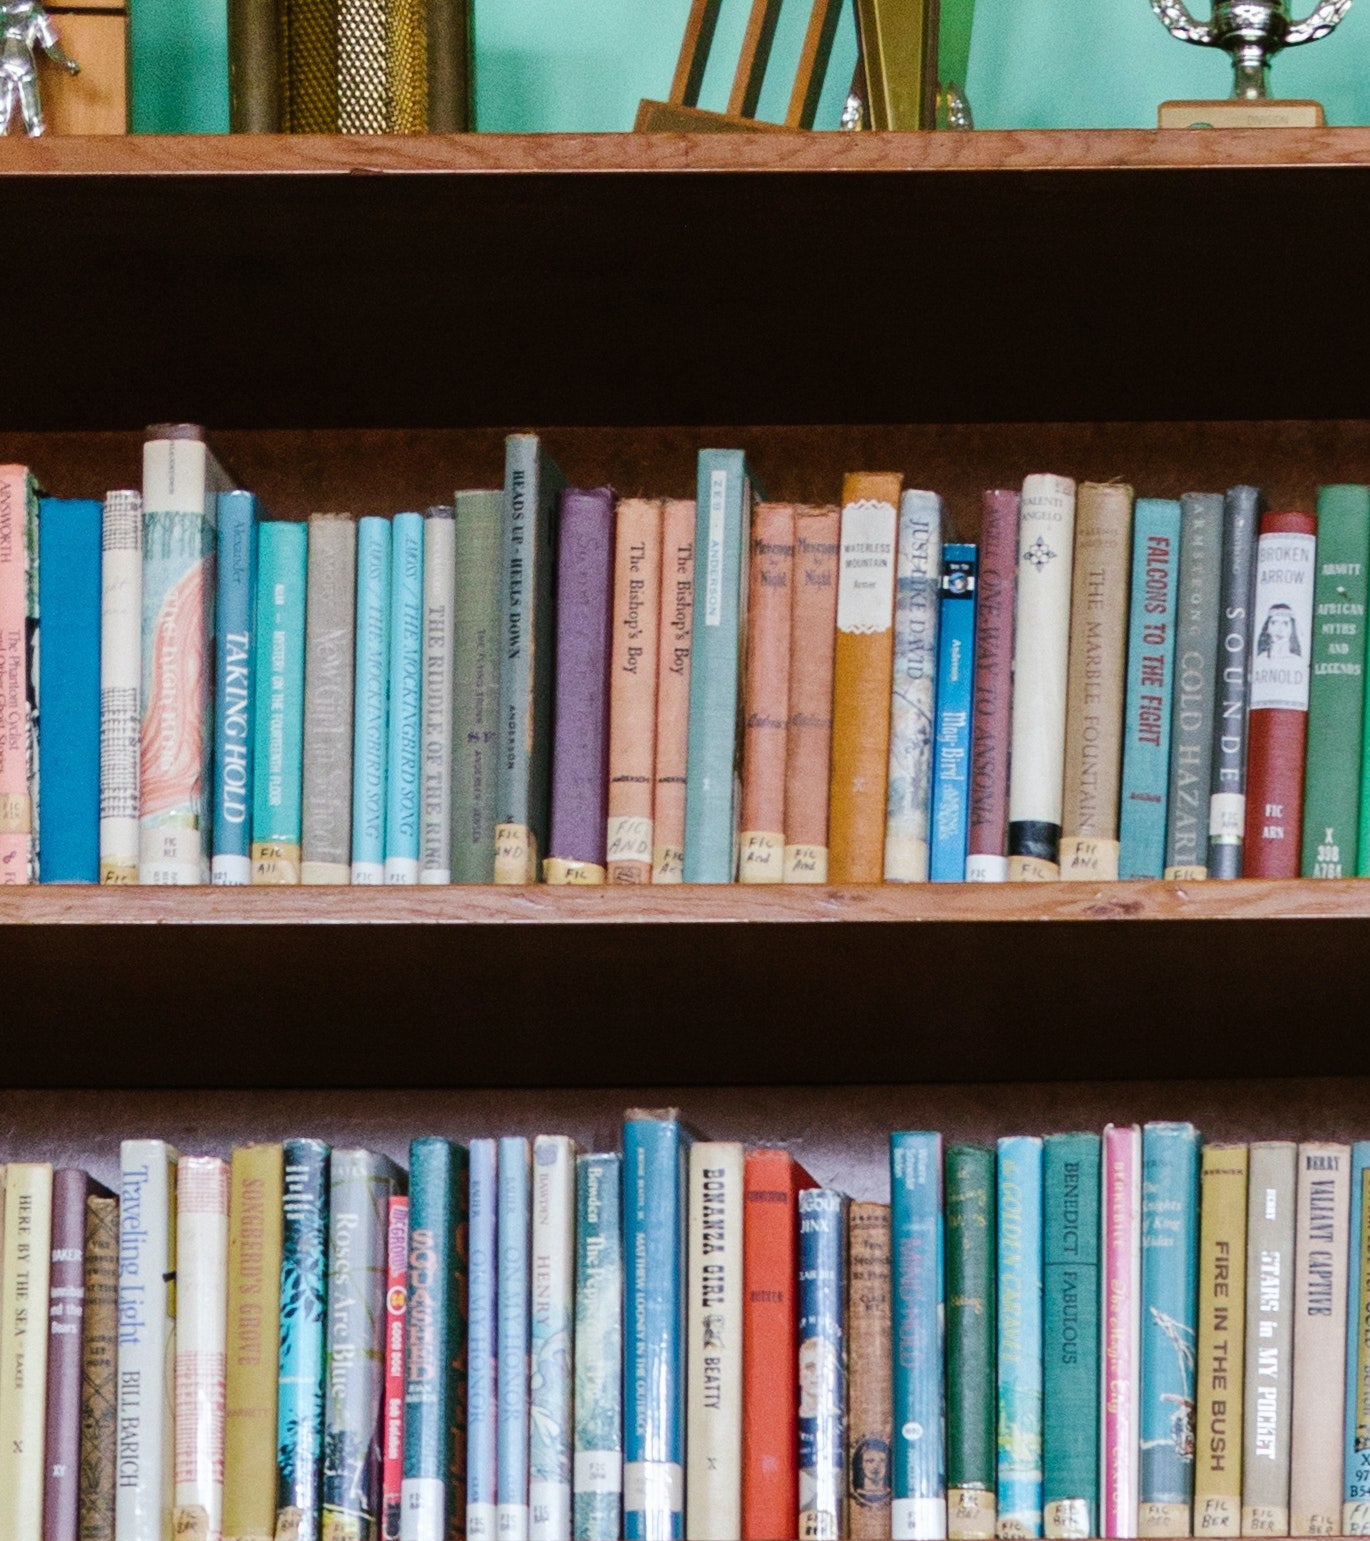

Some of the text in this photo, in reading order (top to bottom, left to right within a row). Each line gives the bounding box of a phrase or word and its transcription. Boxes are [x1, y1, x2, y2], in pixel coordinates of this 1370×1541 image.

[671, 543, 693, 676] The Bishop's Boy
[1138, 535, 1169, 747] FALCONS TO THE FIGHT
[223, 632, 248, 823] TAKING HOLD
[702, 1169, 725, 1307] BONANZA GIRL
[1062, 1162, 1080, 1365] BENEDICT FABULOUS
[1307, 1180, 1335, 1317] VALIANT CAPTIVE
[703, 1357, 721, 1410] BEATTY
[1211, 1241, 1229, 1472] FIRE IN THE BUSH
[119, 1371, 140, 1488] BILL BARICH
